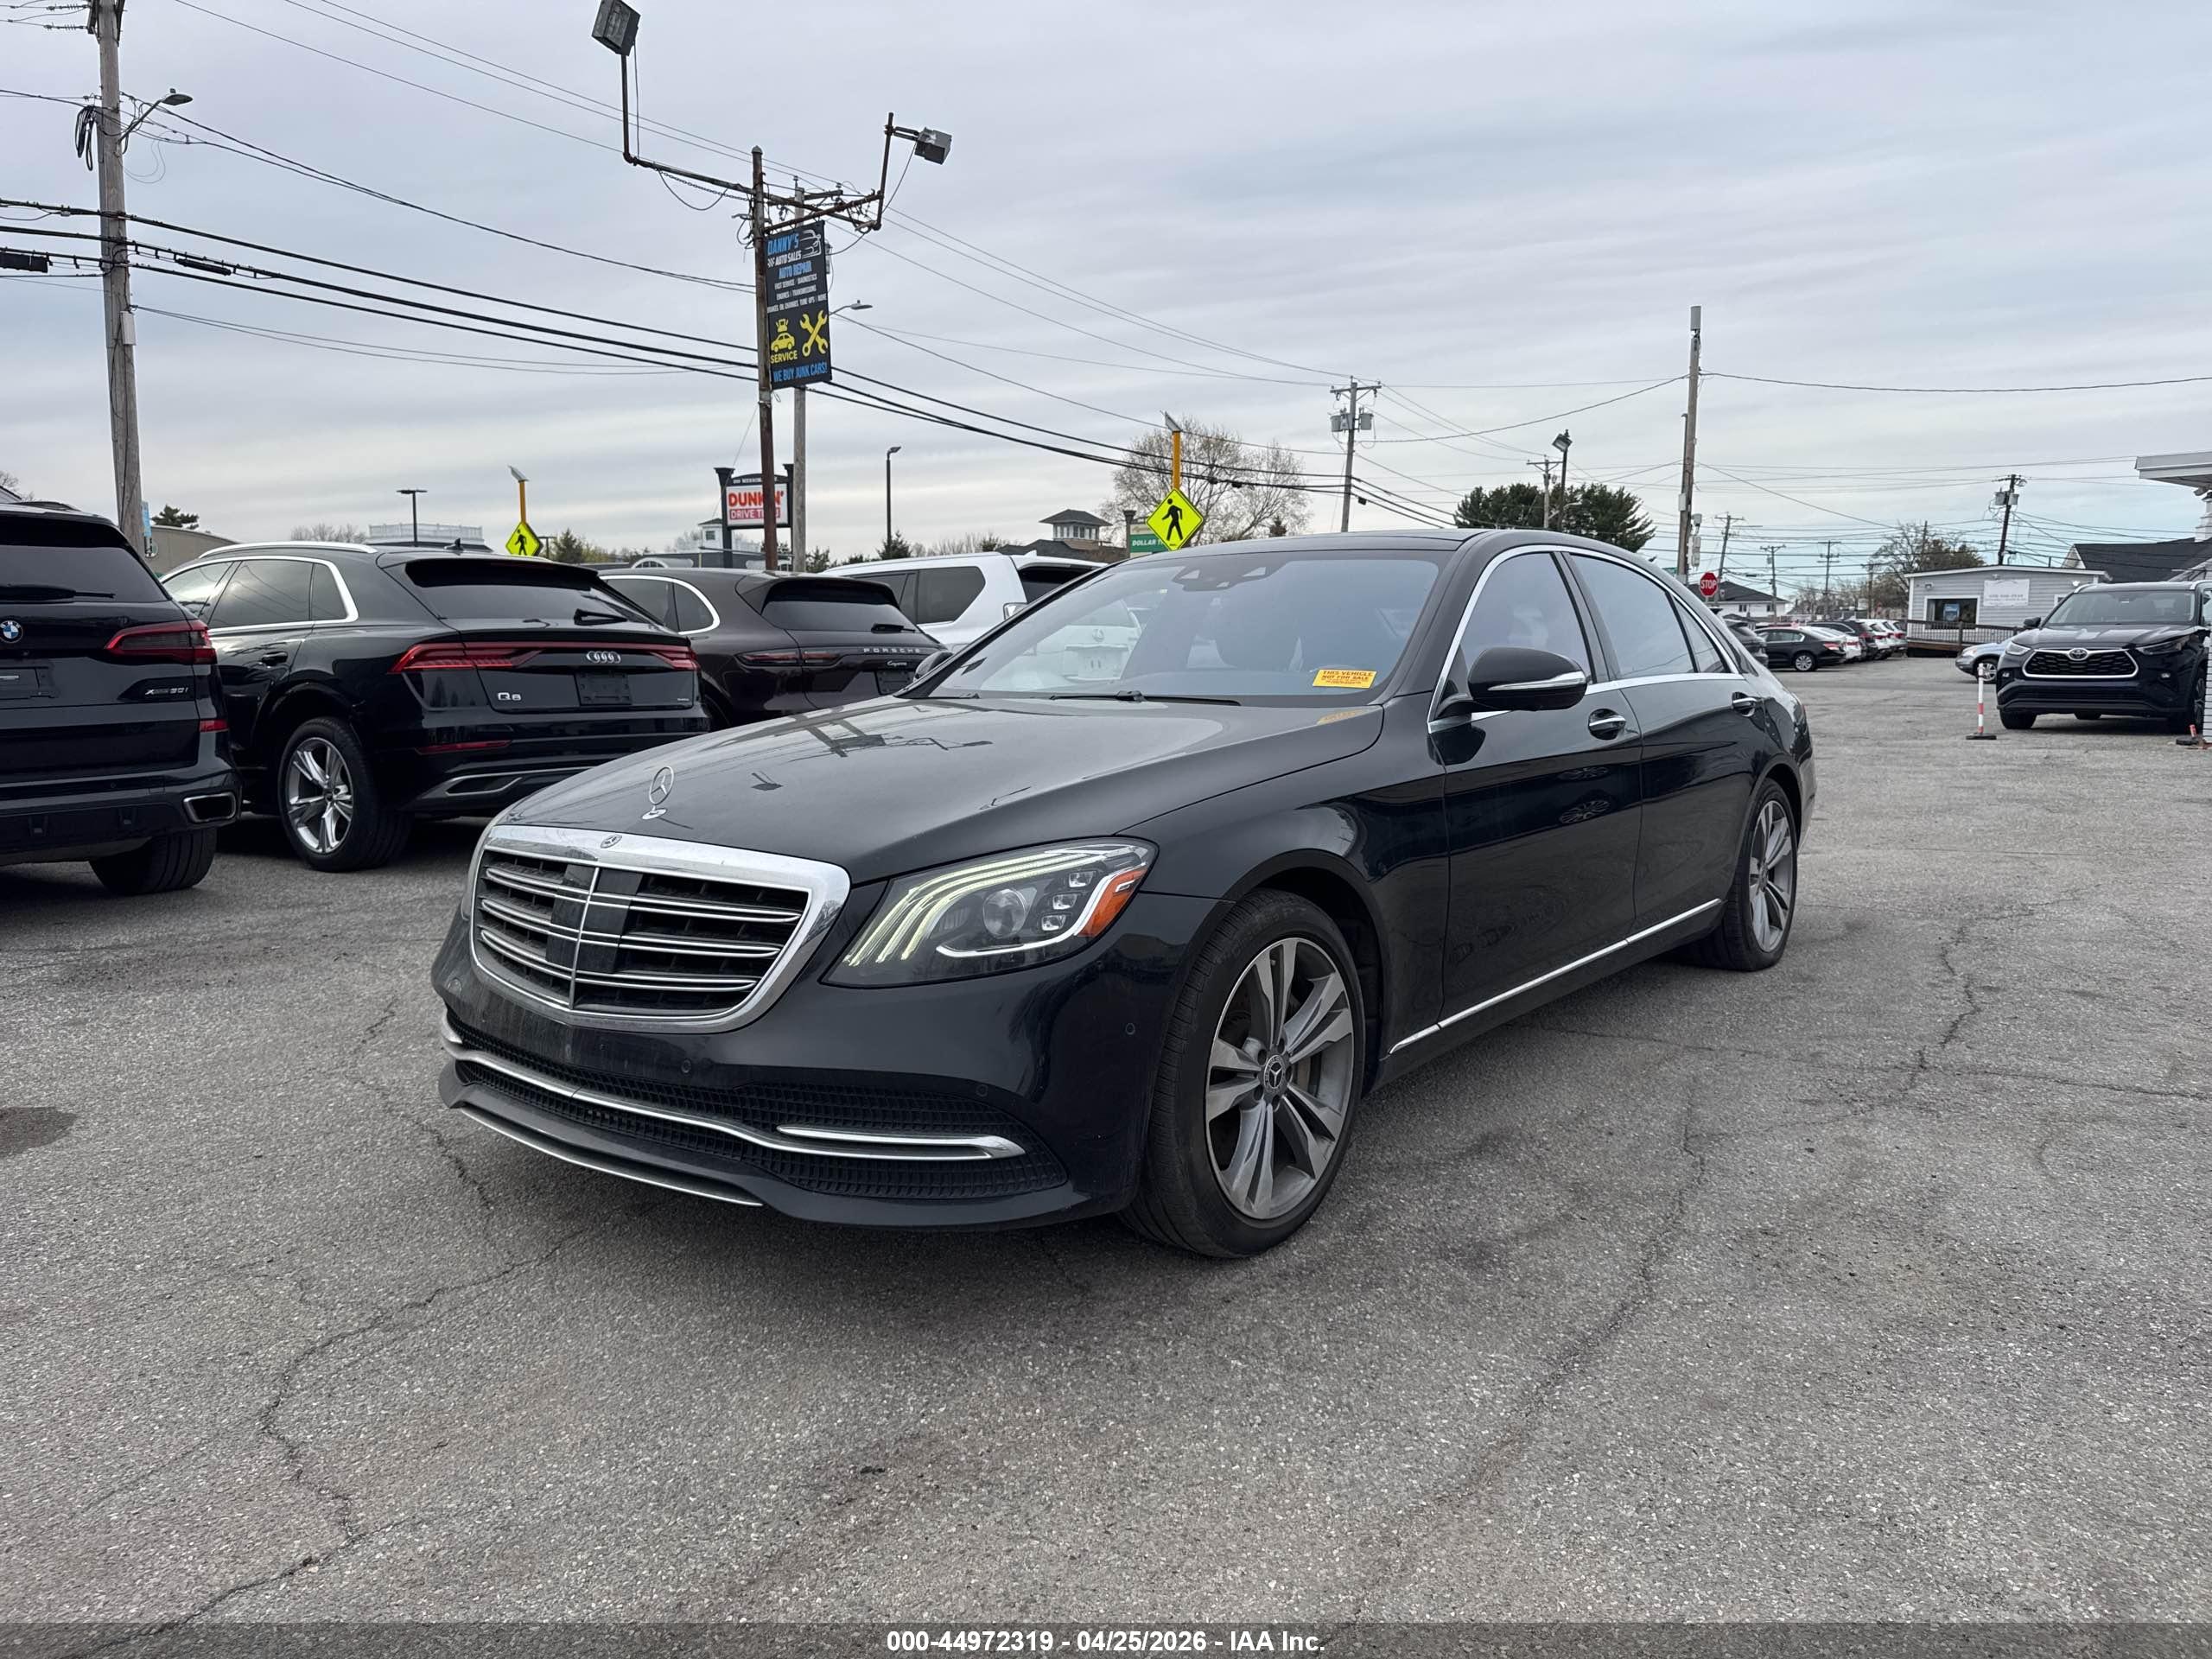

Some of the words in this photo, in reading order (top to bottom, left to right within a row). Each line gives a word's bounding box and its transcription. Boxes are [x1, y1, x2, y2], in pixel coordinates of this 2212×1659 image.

[767, 232, 799, 256] DANNY'S
[775, 253, 788, 266] AUTO
[787, 250, 802, 263] SALES
[779, 264, 793, 279] AUTO
[792, 260, 812, 276] REPAIR
[770, 350, 798, 364] SERVICE
[773, 369, 782, 383] WE
[783, 367, 794, 381] BUY
[796, 365, 810, 378] JUNK
[810, 361, 828, 376] CARS!
[728, 490, 784, 506] DUNKN'
[731, 510, 755, 518] DRIVE
[1700, 579, 1717, 589] STOP
